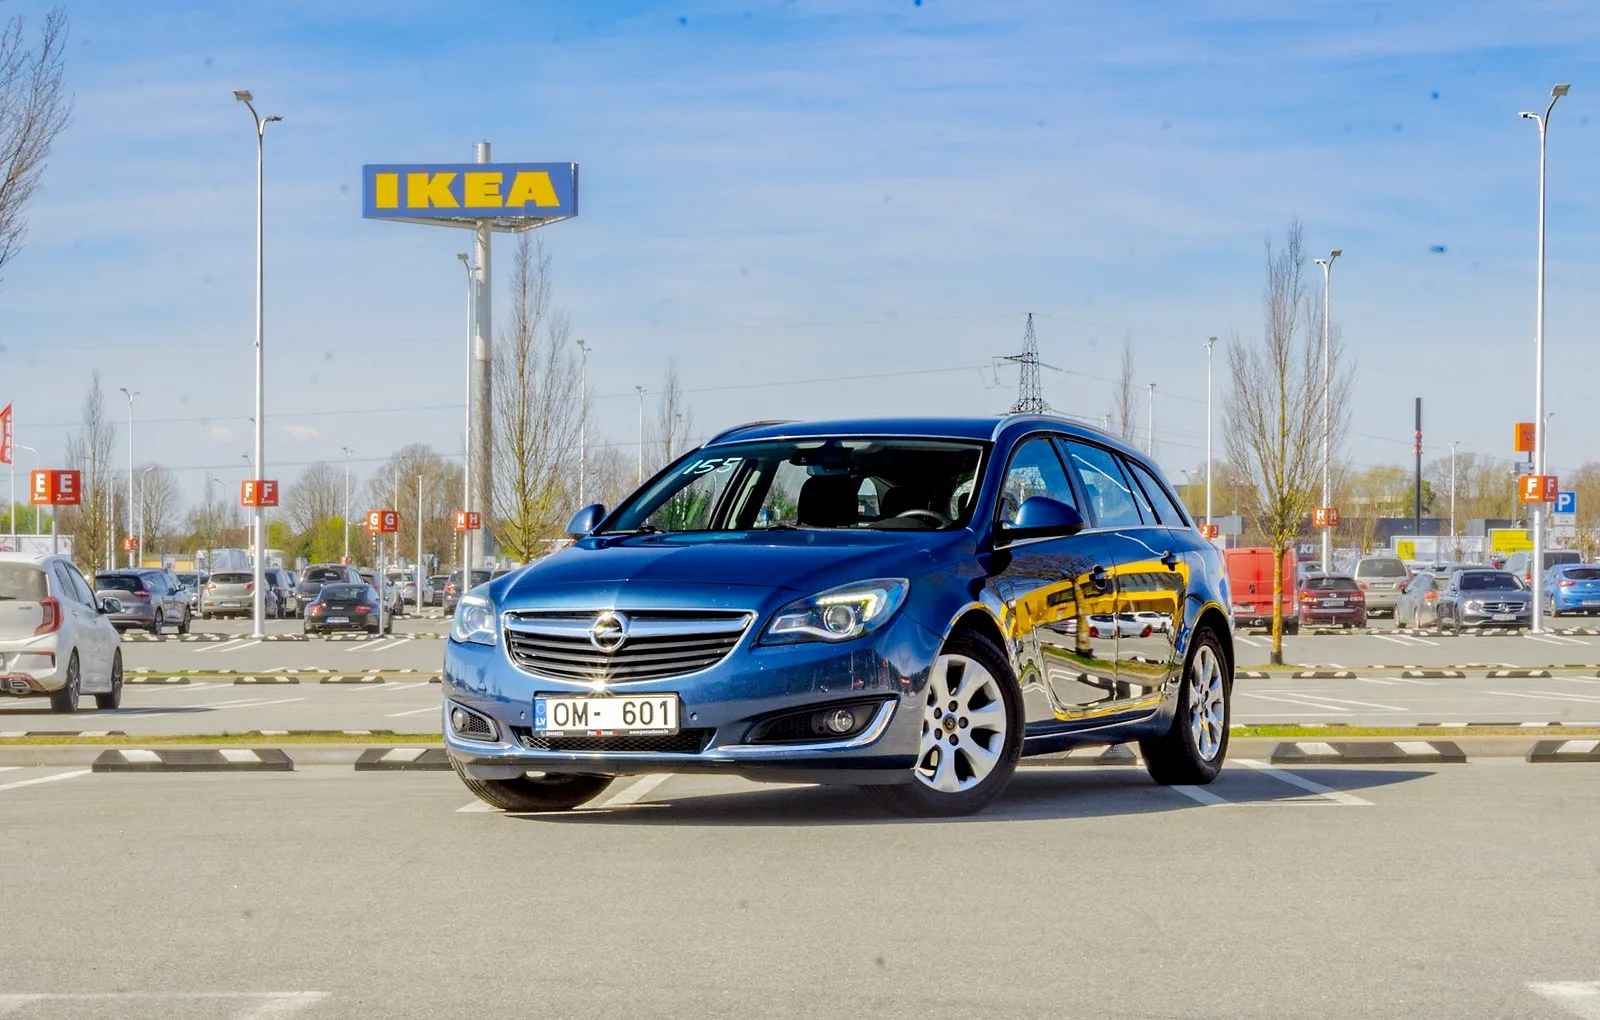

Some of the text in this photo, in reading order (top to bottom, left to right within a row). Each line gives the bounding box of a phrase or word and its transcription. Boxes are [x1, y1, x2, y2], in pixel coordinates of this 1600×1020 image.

[375, 172, 560, 208] IKEA
[683, 457, 743, 474] 155
[36, 473, 45, 493] E
[60, 474, 72, 493] E
[245, 483, 253, 497] F
[264, 483, 272, 497] F
[1527, 479, 1537, 493] F
[1547, 479, 1555, 493] F
[1559, 494, 1571, 511] P
[370, 512, 379, 525] G
[385, 513, 394, 525] G
[458, 513, 464, 523] H
[470, 514, 477, 523] H
[1316, 510, 1324, 520] H
[622, 701, 668, 725] 601
[536, 717, 546, 725] LV
